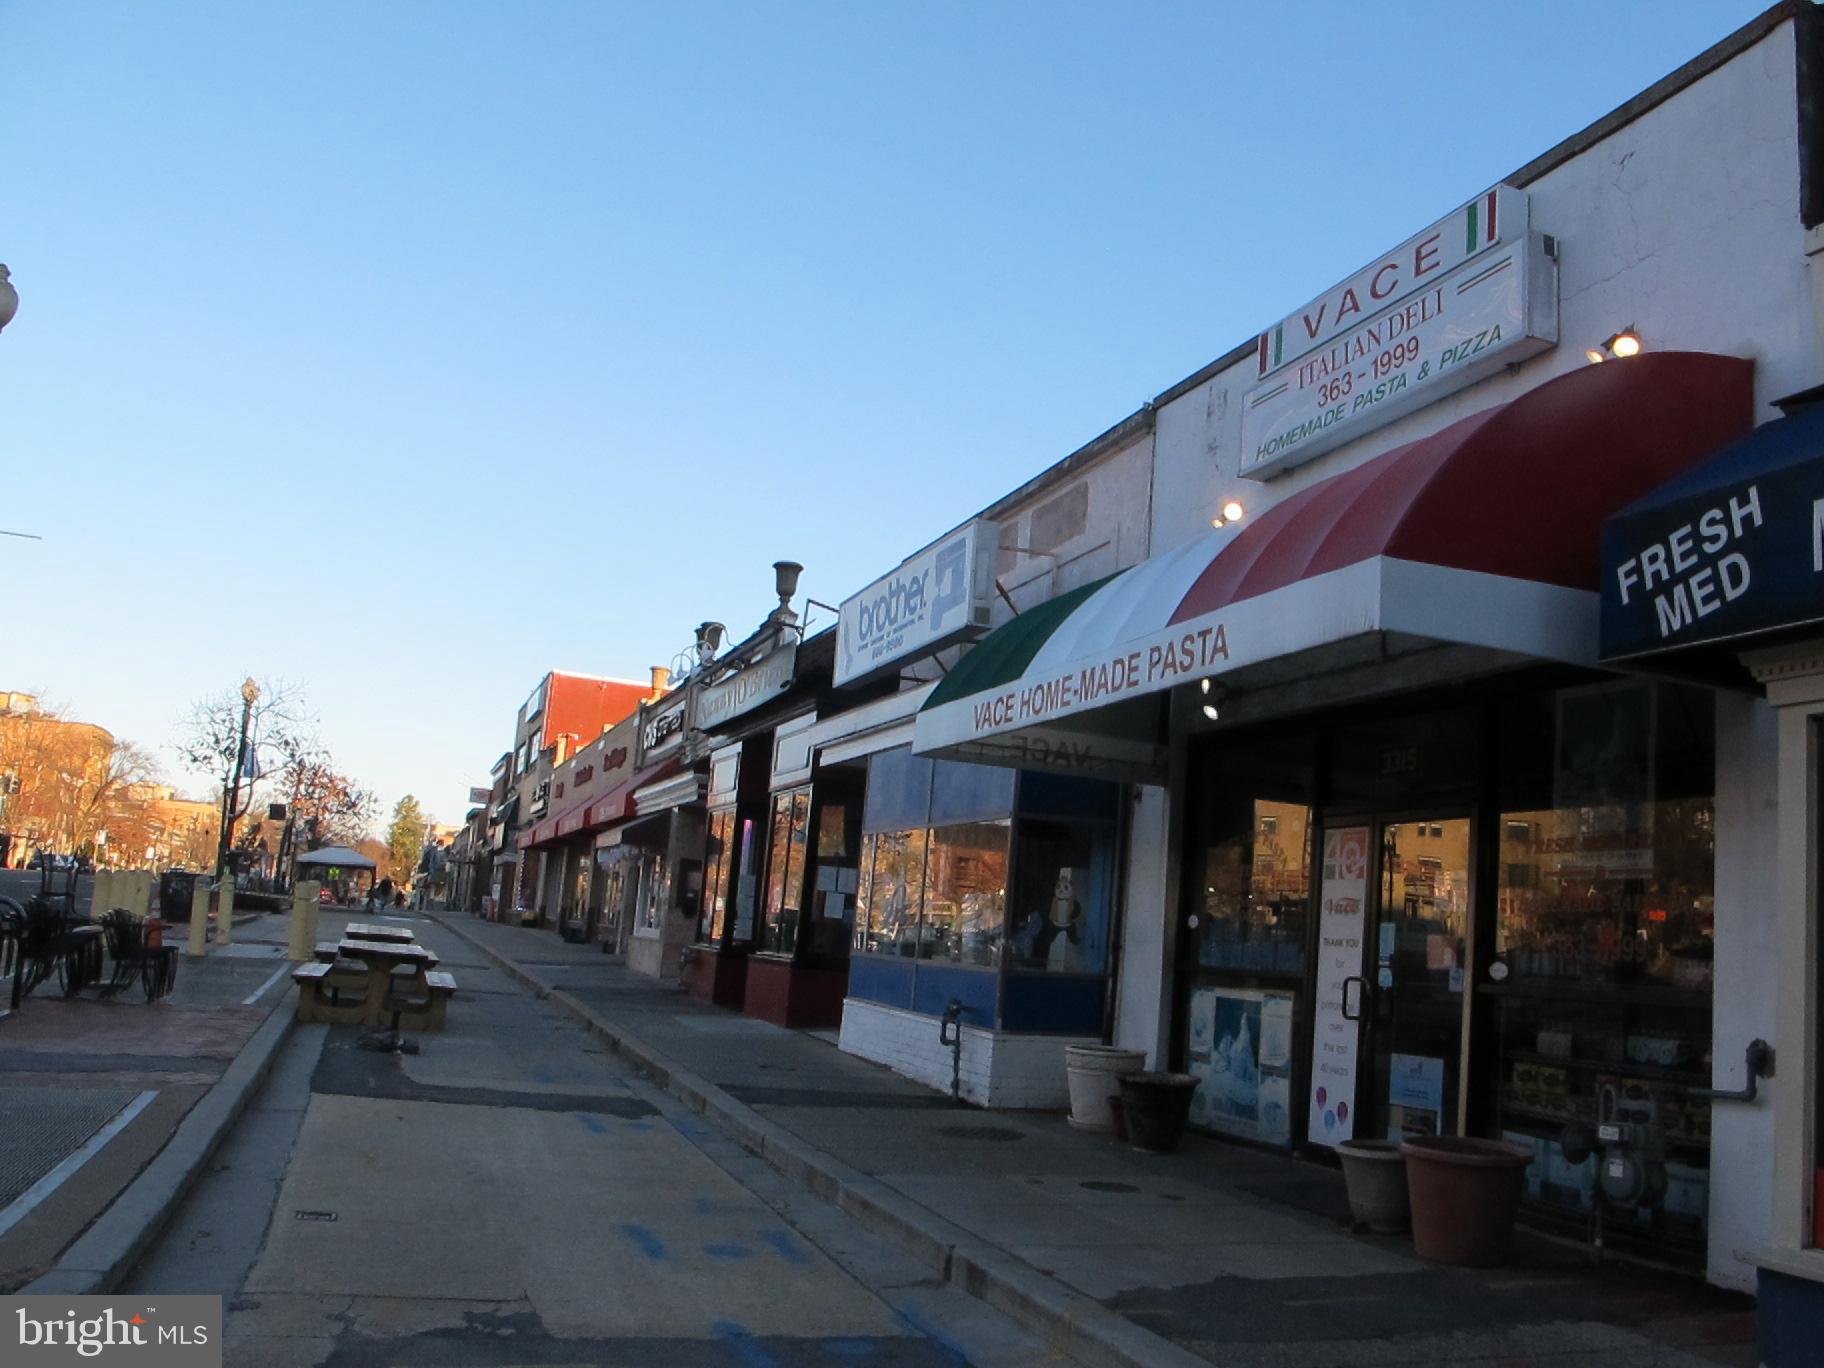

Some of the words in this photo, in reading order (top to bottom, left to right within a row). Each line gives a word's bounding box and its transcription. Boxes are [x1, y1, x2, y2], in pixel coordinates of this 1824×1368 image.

[1298, 324, 1382, 389] ITALIAN
[1388, 288, 1444, 341] DELI
[1303, 233, 1441, 339] VACE
[1256, 406, 1345, 461] HOMEMADE
[1352, 376, 1408, 412] PASTA
[1417, 361, 1430, 379] &
[1440, 324, 1502, 369] PIZZA
[1617, 485, 1763, 605] FRESH
[1654, 552, 1750, 638] MED
[858, 568, 928, 641] brother
[974, 692, 1015, 731] VACE
[1019, 652, 1140, 720] HOME-MADE
[1149, 624, 1229, 682] PASTA
